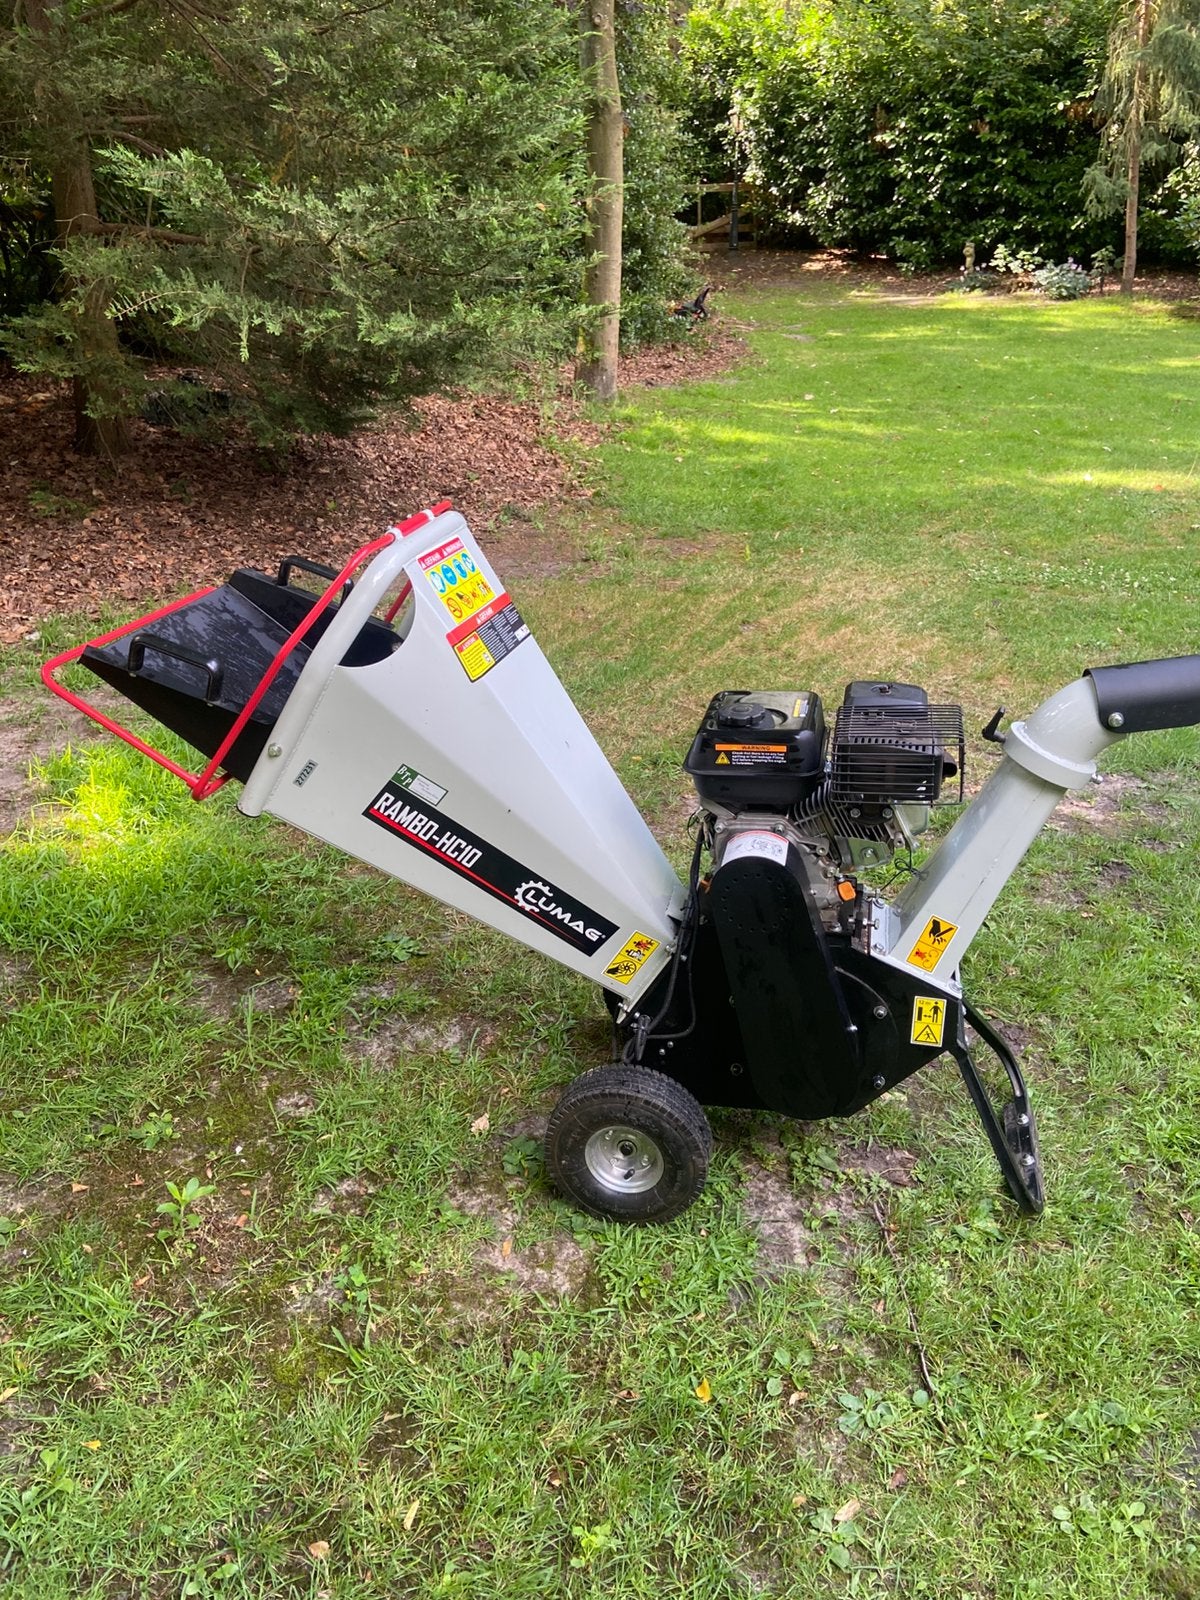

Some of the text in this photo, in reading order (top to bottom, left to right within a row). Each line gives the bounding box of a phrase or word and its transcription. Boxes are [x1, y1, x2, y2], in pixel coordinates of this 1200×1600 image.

[296, 762, 316, 786] 277231
[398, 766, 413, 785] BTP
[373, 792, 483, 868] RAMBO-HC10
[524, 889, 603, 942] LUMAG
